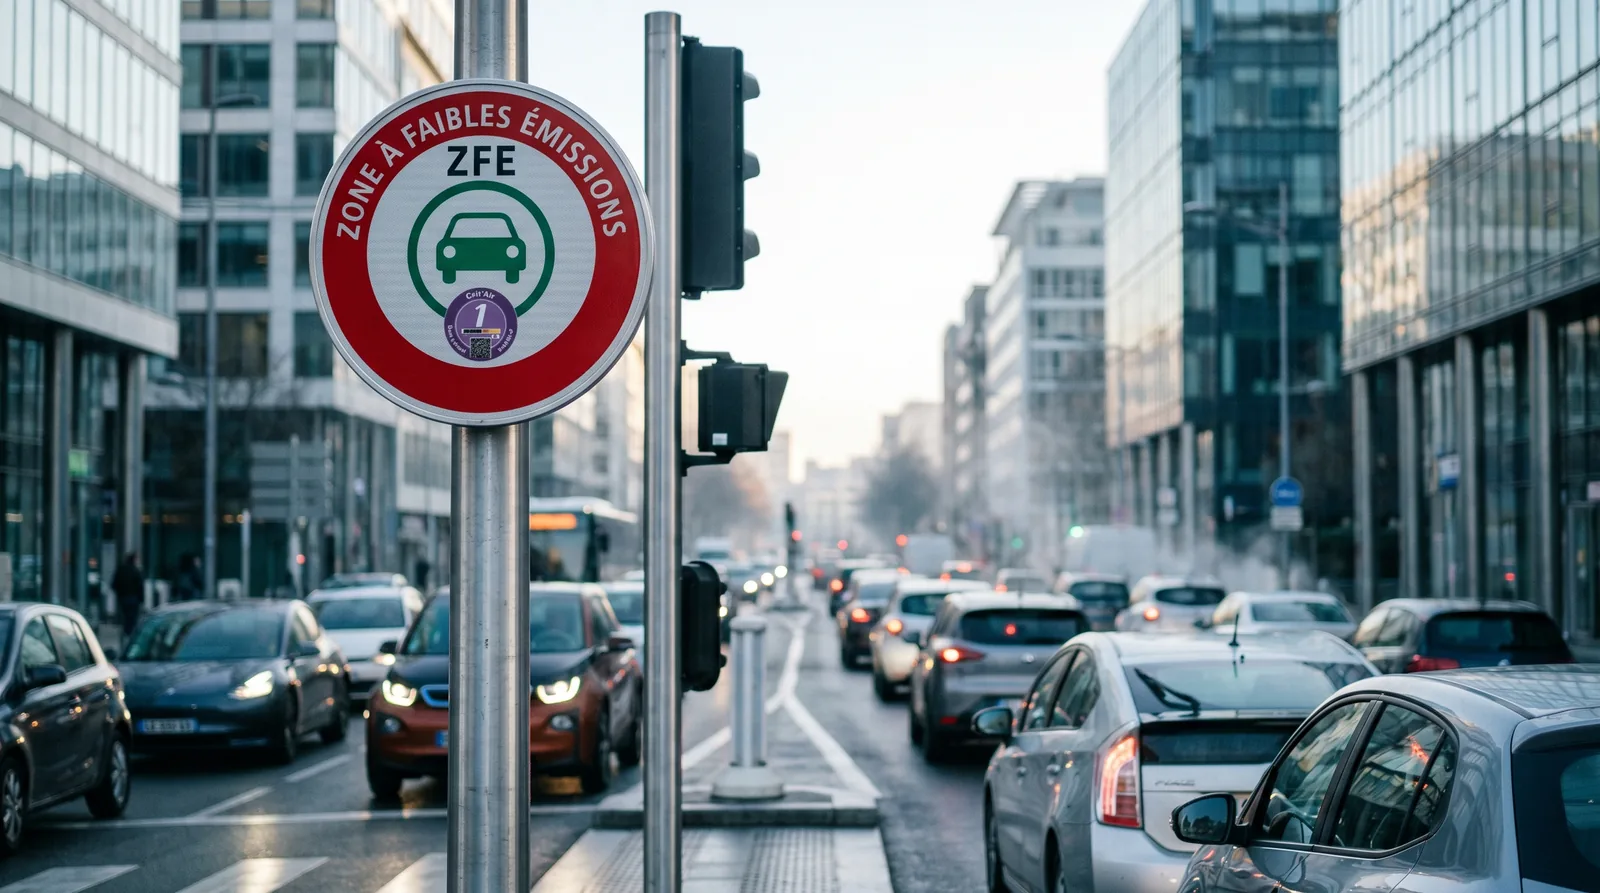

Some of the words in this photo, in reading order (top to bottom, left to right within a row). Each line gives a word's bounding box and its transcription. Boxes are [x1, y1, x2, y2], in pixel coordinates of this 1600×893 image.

[337, 163, 384, 240] ZONE
[375, 140, 405, 167] À
[400, 104, 512, 149] FAIBLES
[519, 107, 627, 237] ÉMISSIONS
[447, 145, 516, 176] ZFE
[475, 303, 487, 328] 1
